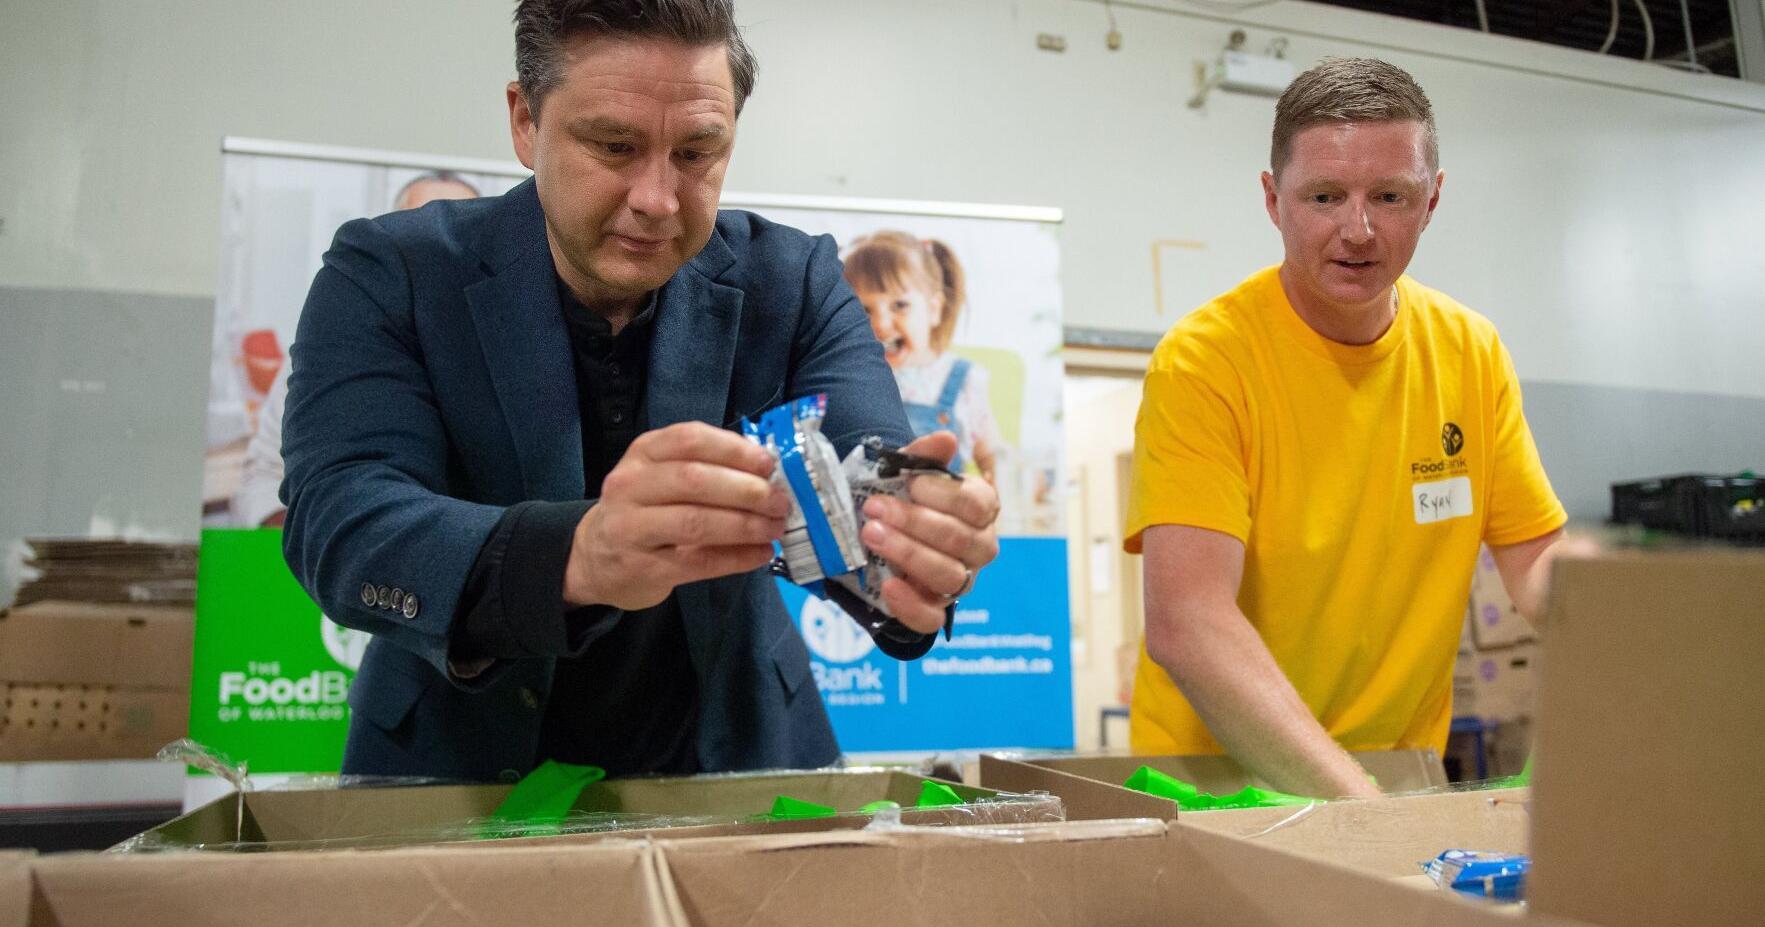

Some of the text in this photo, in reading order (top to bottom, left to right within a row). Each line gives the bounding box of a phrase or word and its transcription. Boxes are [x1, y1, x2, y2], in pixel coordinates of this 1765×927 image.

[248, 661, 281, 676] THE
[809, 661, 883, 690] Bank
[219, 670, 350, 705] FoodB
[217, 705, 344, 722] OF WATERLOO
